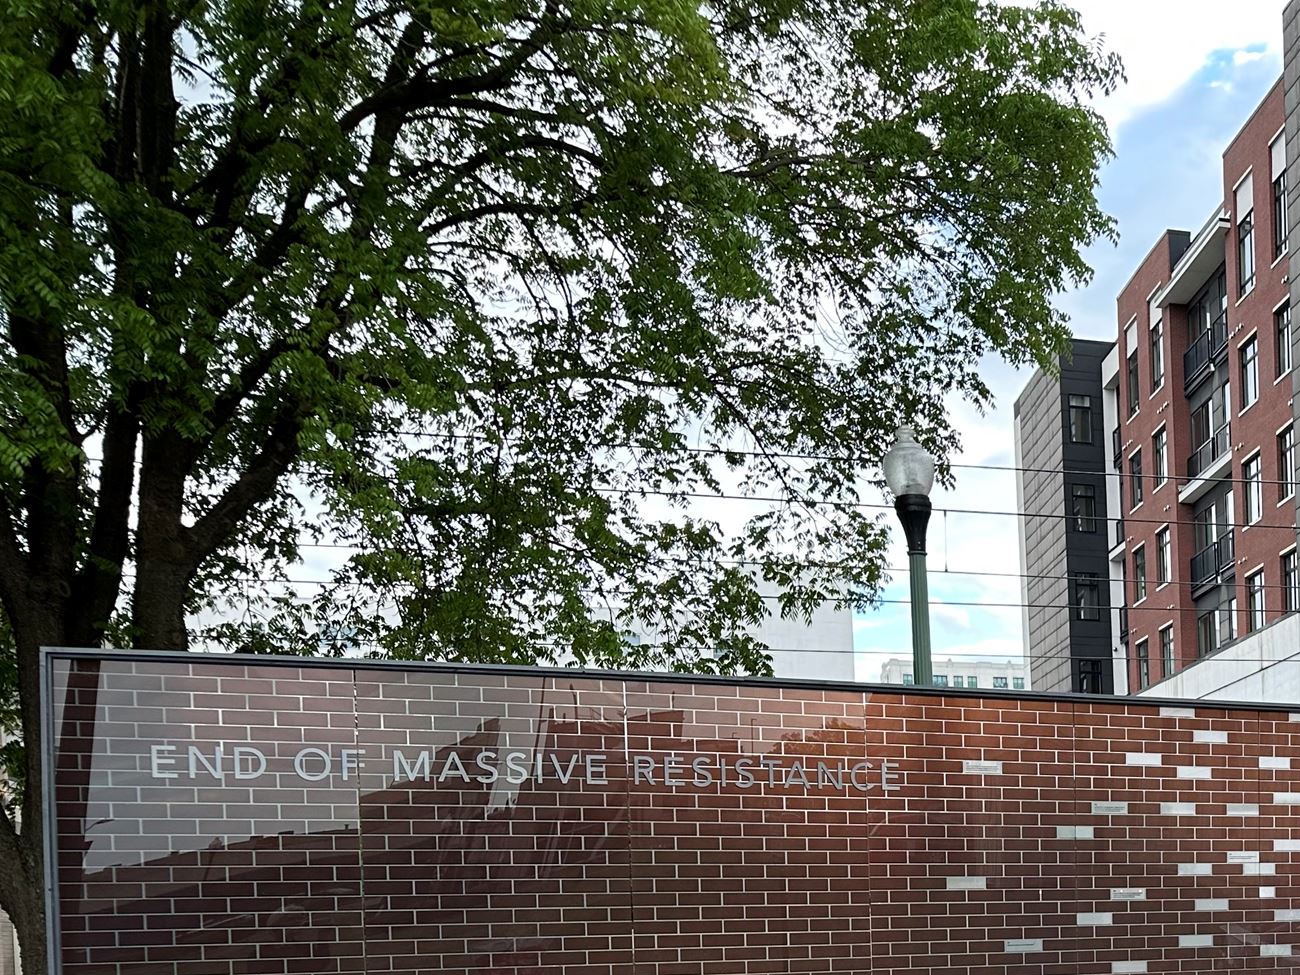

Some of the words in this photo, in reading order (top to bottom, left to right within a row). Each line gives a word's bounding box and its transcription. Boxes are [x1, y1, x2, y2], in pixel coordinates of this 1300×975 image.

[150, 744, 267, 780] END
[294, 747, 366, 781] OF
[392, 749, 609, 785] MASSIVE
[633, 754, 901, 791] RESISTANCE
